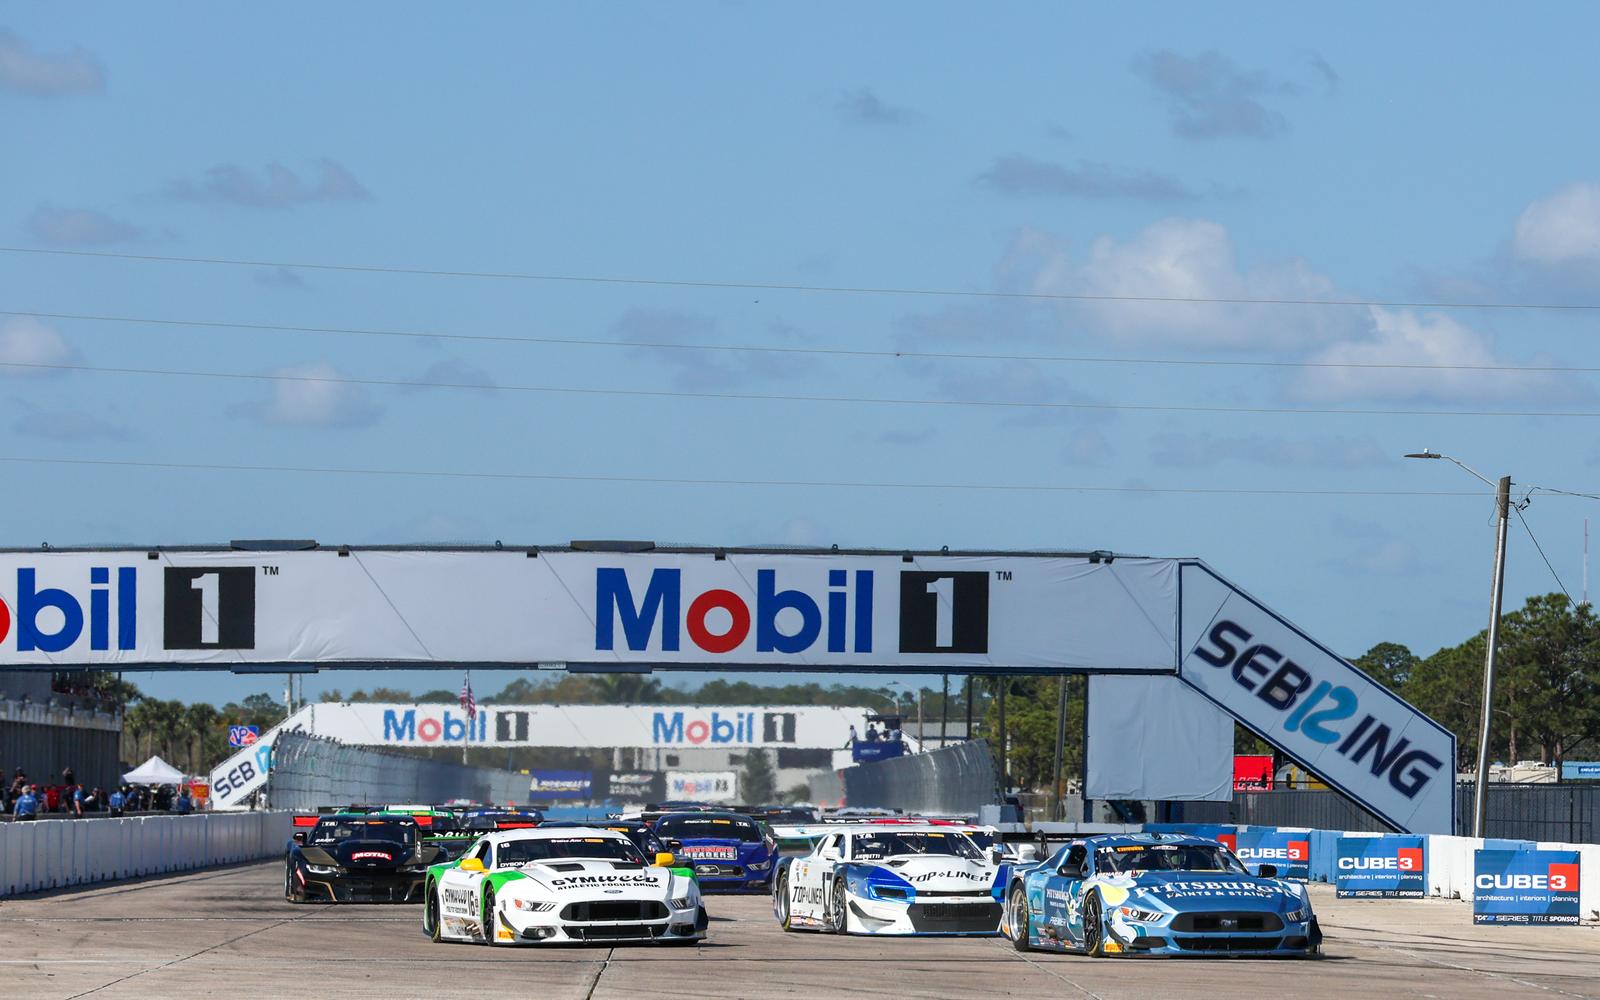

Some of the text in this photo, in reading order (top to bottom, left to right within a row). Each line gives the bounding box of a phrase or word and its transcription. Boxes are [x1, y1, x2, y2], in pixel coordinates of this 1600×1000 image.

[0, 567, 136, 652] bil
[190, 573, 220, 644] 1
[595, 567, 874, 654] Mobil
[926, 577, 954, 648] 1
[384, 709, 518, 742] Mobil 1
[653, 712, 784, 743] Mobil 1
[1098, 846, 1115, 854] TA
[1237, 847, 1301, 859] CUBE3
[1338, 856, 1413, 870] CUBE3
[945, 870, 990, 882] LINER
[1475, 874, 1567, 889] CUBE3
[1551, 896, 1579, 904] planning
